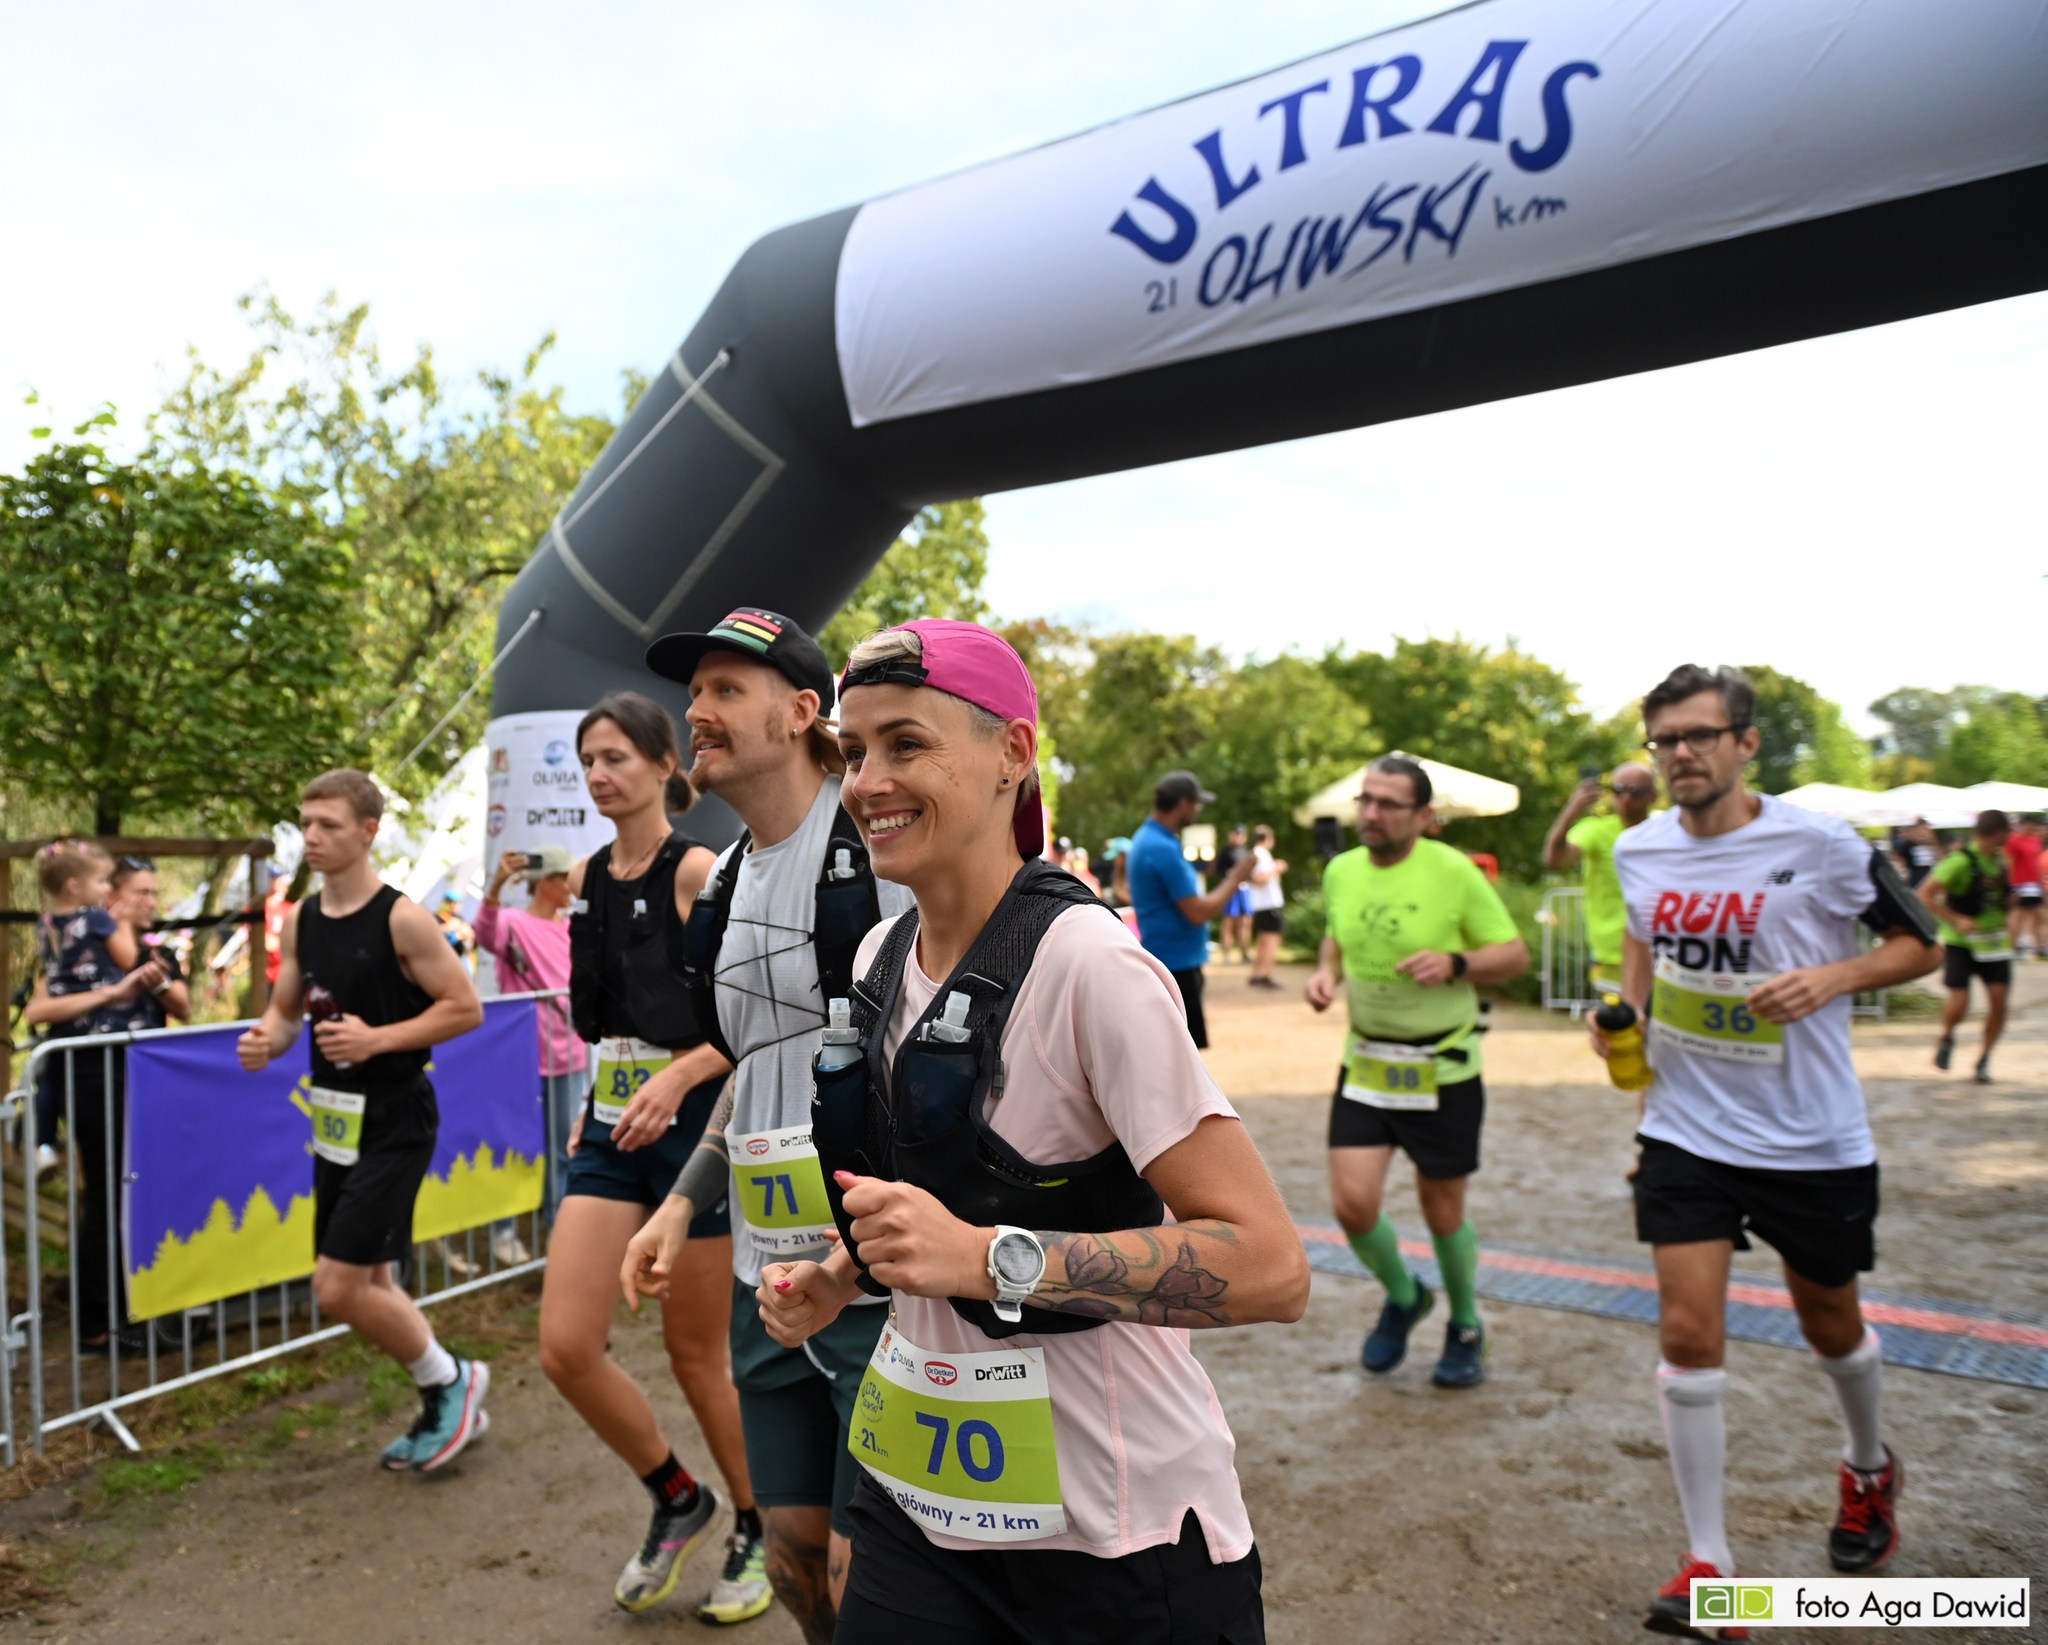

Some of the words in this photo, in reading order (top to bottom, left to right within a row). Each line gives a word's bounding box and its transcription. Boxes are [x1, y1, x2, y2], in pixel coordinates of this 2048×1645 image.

[1109, 39, 1602, 265] ULTRAS
[1143, 276, 1177, 313] 21
[1493, 195, 1567, 230] km
[532, 771, 579, 787] OLIVIA
[1651, 890, 1767, 935] RUN
[1703, 1001, 1756, 1035] 36
[751, 1174, 799, 1217] 71
[792, 1234, 805, 1245] 21
[898, 1353, 915, 1370] OLIVIA
[975, 1364, 1027, 1381] DrWitt
[861, 1381, 885, 1411] ULTRAS
[861, 1427, 876, 1452] 21
[915, 1411, 1005, 1483] 70
[897, 1492, 953, 1527] główny
[976, 1512, 996, 1529] 21
[1004, 1513, 1040, 1530] km
